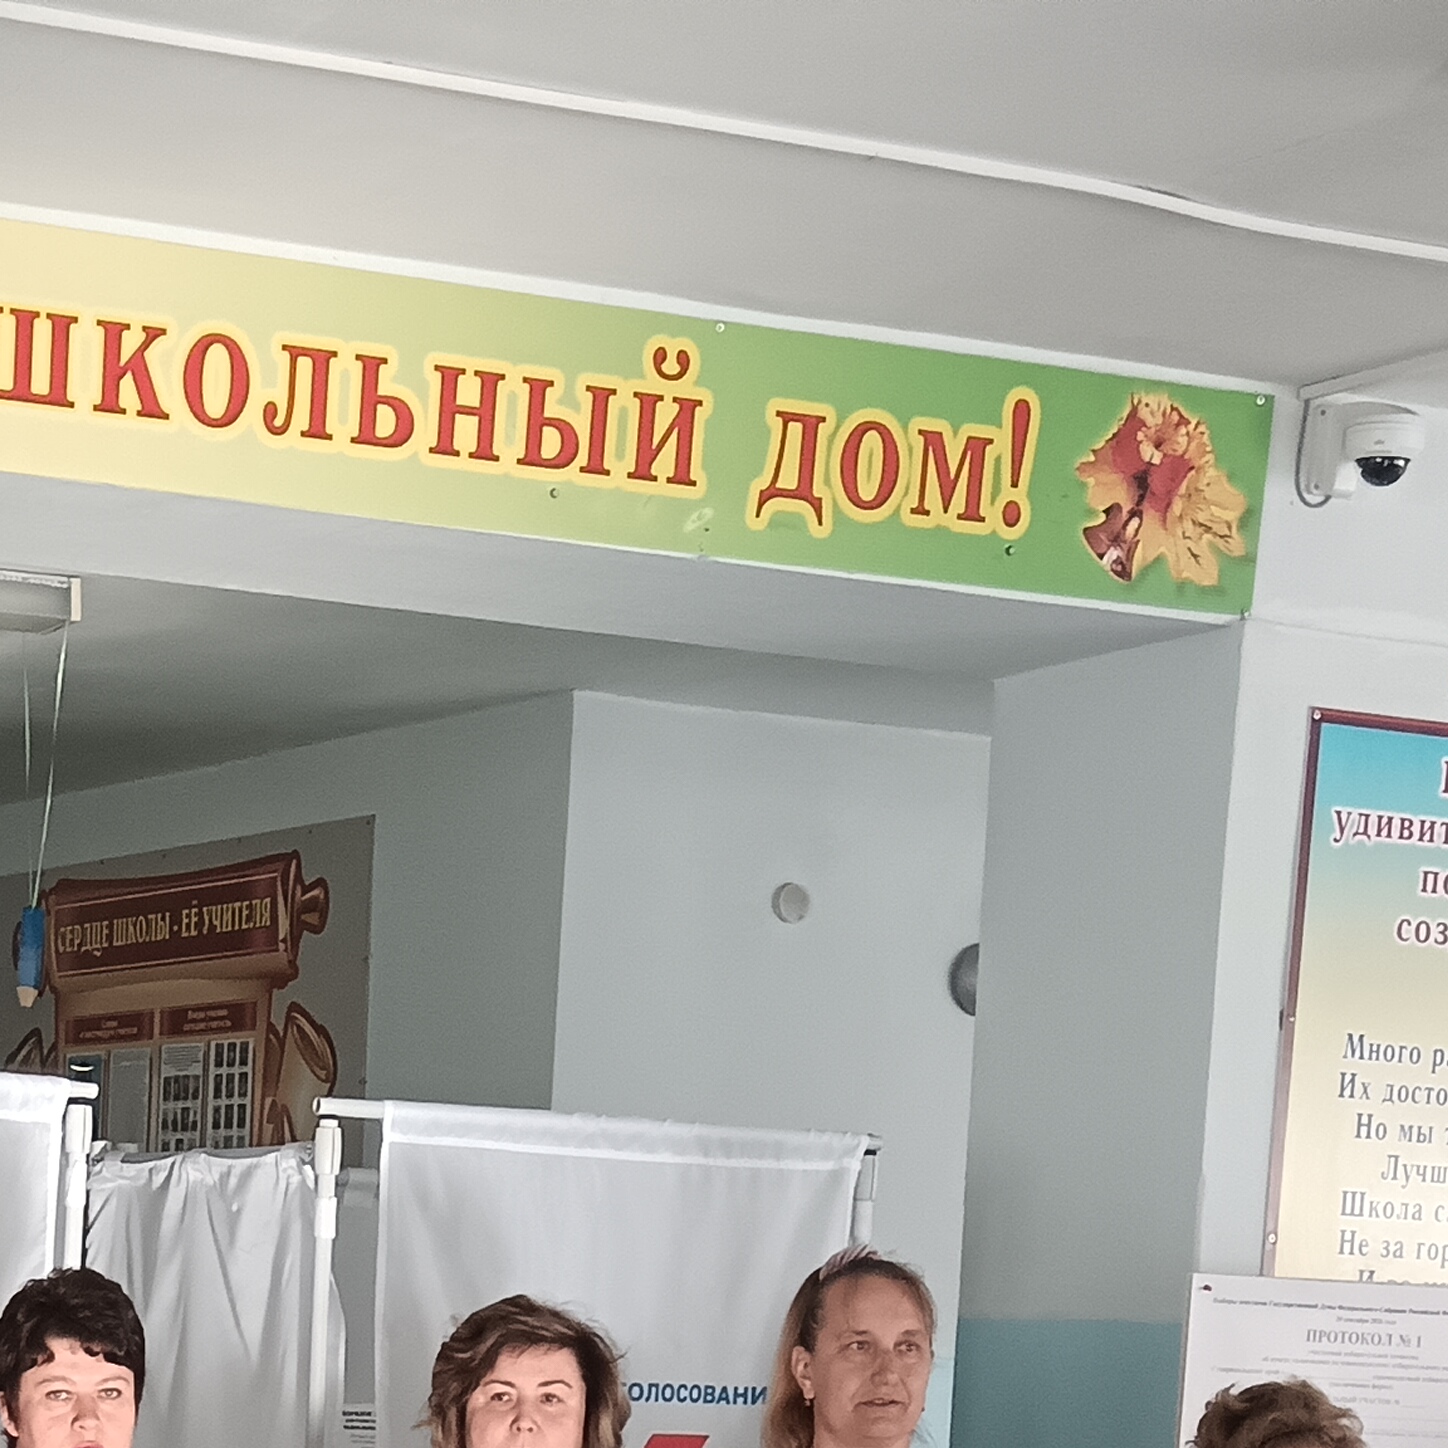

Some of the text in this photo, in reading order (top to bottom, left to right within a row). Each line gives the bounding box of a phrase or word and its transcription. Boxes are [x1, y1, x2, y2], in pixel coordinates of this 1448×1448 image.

[754, 399, 1036, 530] дом!
[58, 920, 110, 957] СЕРДЦЕ
[112, 914, 171, 947] ШКОЛЫ
[202, 896, 272, 936] УЧИТЕЛЯ
[1342, 1032, 1422, 1067] Много
[1336, 1072, 1372, 1103] Их
[1354, 1113, 1389, 1143] Но
[1397, 1120, 1435, 1145] мы
[1339, 1190, 1425, 1223] Школа
[1336, 1229, 1371, 1258] Не
[1379, 1236, 1405, 1261] за
[1305, 1327, 1394, 1349] ПРОТОКОЛ
[1415, 1335, 1423, 1349] 1
[622, 1381, 768, 1406] ОЛОСОВАНИ
